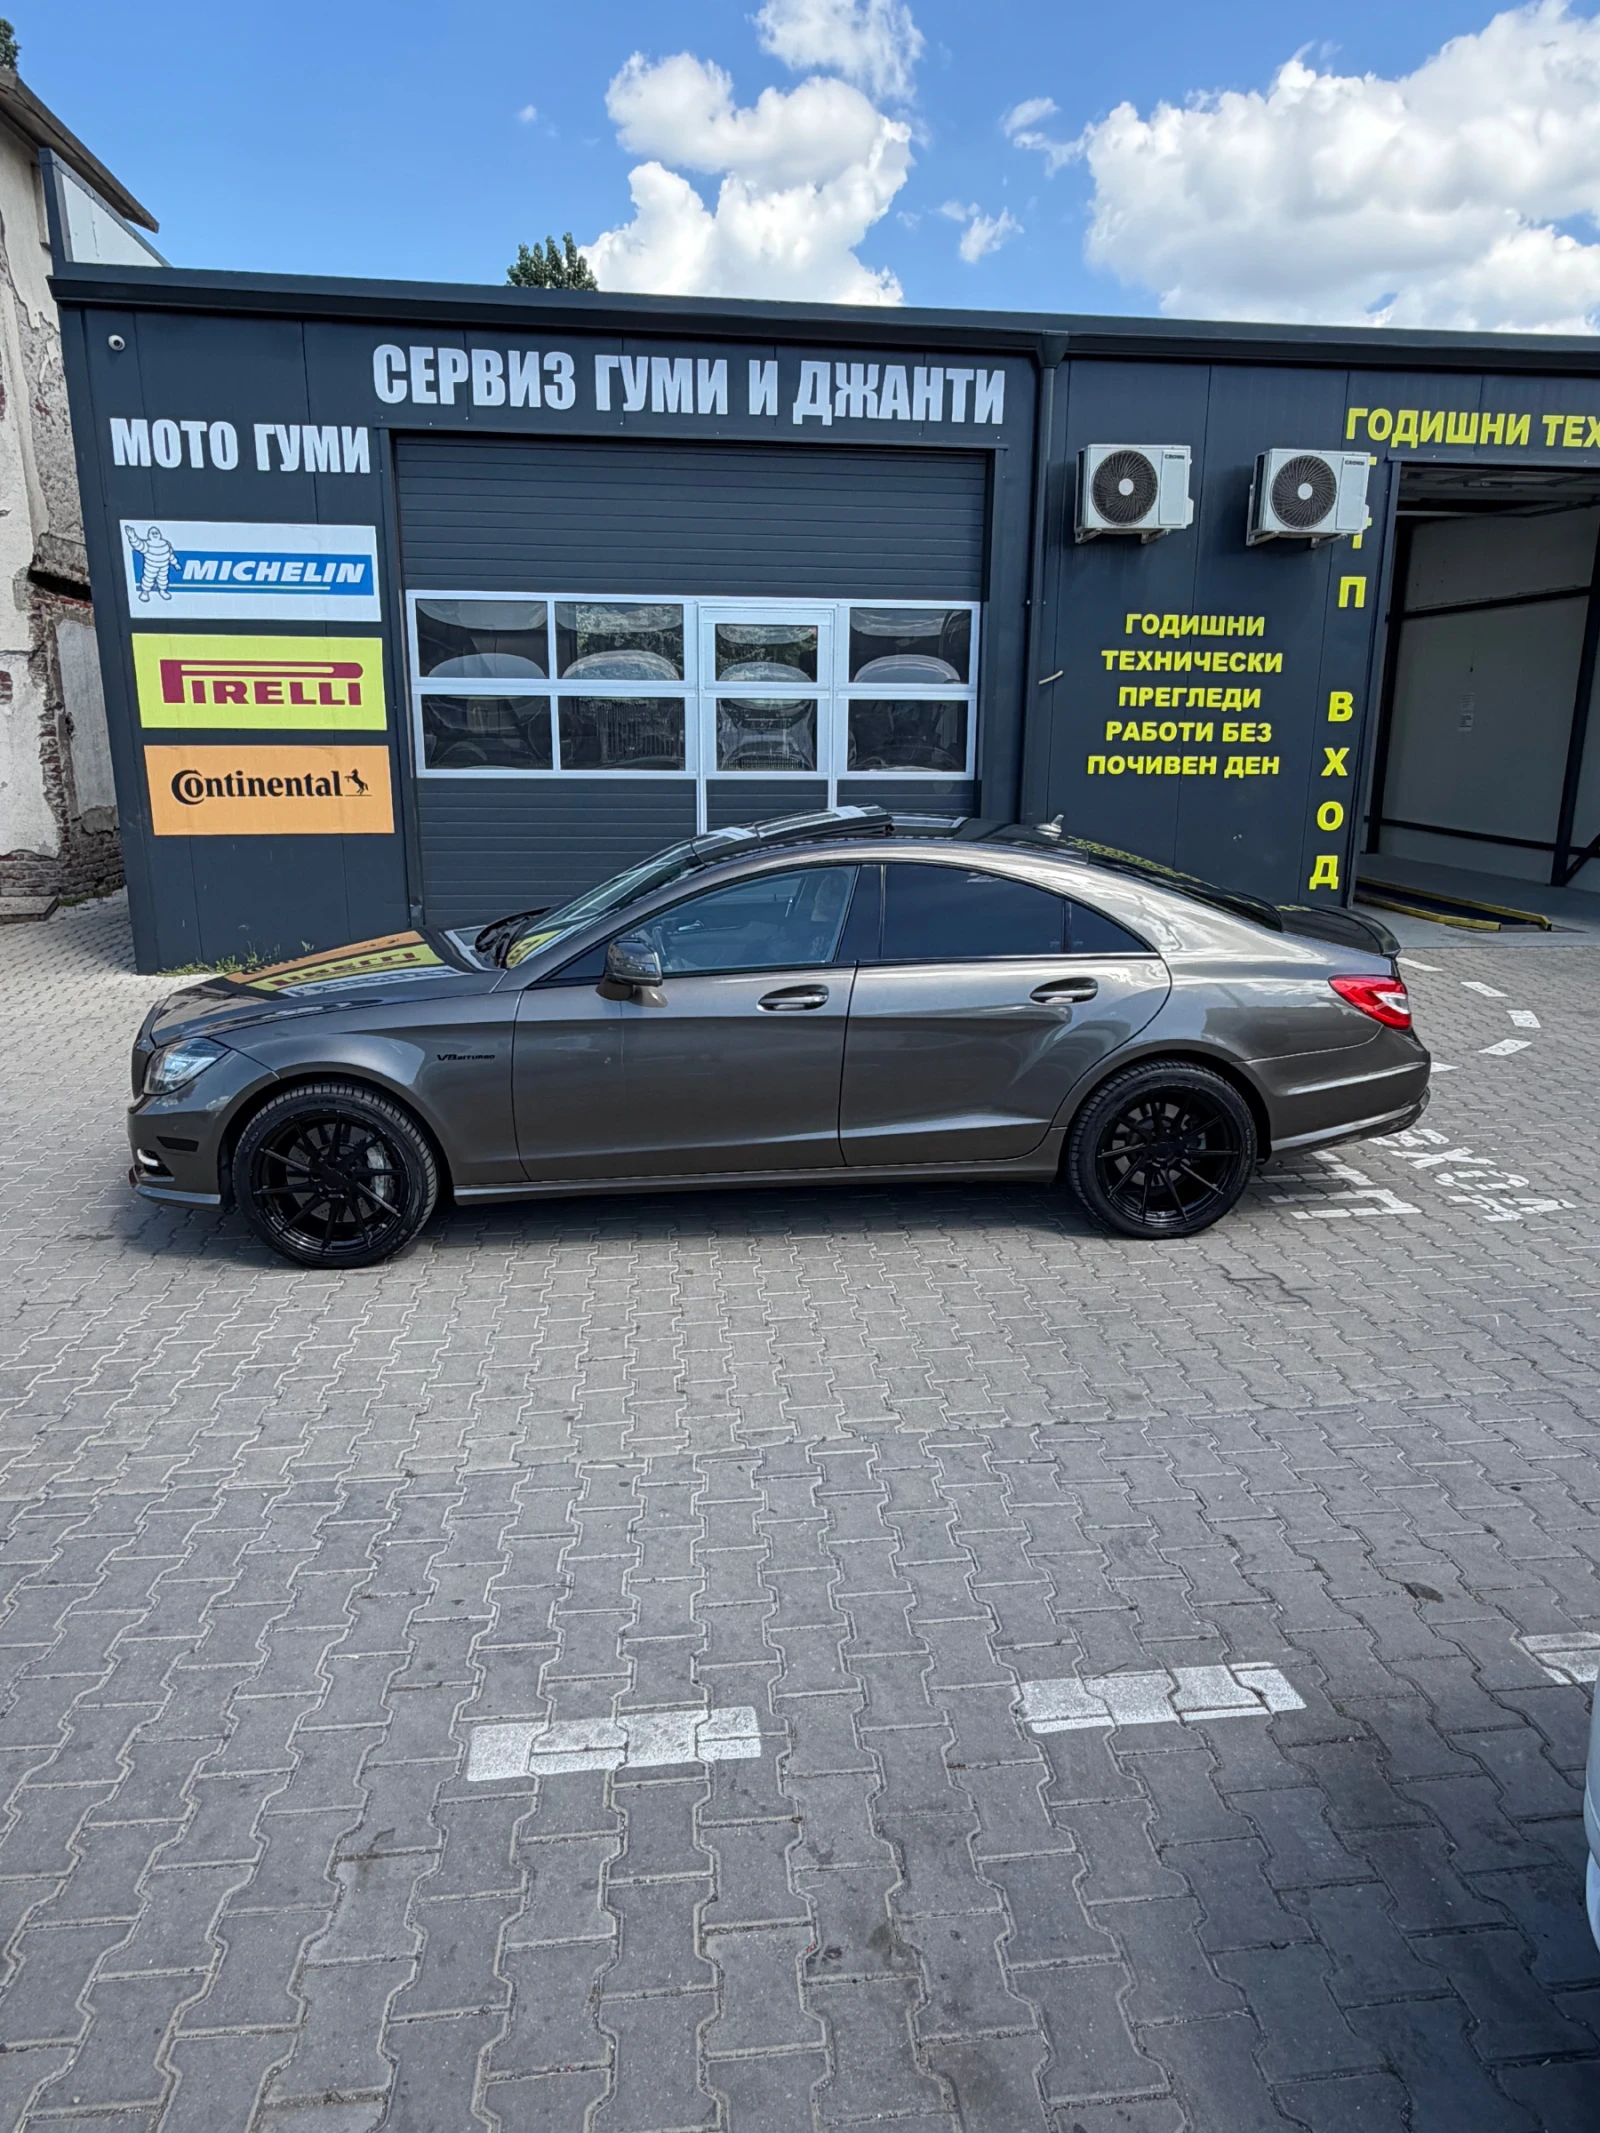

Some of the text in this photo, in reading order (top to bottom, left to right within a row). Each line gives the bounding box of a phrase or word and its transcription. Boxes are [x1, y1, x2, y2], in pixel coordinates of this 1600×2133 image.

[373, 344, 1005, 426] СЕРВИЗ ГУМИ И ДЖАНТИ
[1346, 407, 1531, 449] ГОДИШНИ
[109, 417, 371, 474] МОТО ГУМИ
[182, 559, 365, 584] MICHELIN
[1125, 613, 1265, 639] ГОДИШНИ
[1101, 650, 1283, 674] ТЕХНИЧЕСКИ
[159, 659, 364, 706] PIRELLI
[1118, 686, 1262, 712] ПРЕГЛЕДИ
[1105, 721, 1273, 743] РАБОТИ БЕЗ
[1087, 755, 1281, 779] ПОЧИВЕН ДЕН
[171, 769, 343, 806] Continental
[1308, 691, 1354, 891] ВХОД
